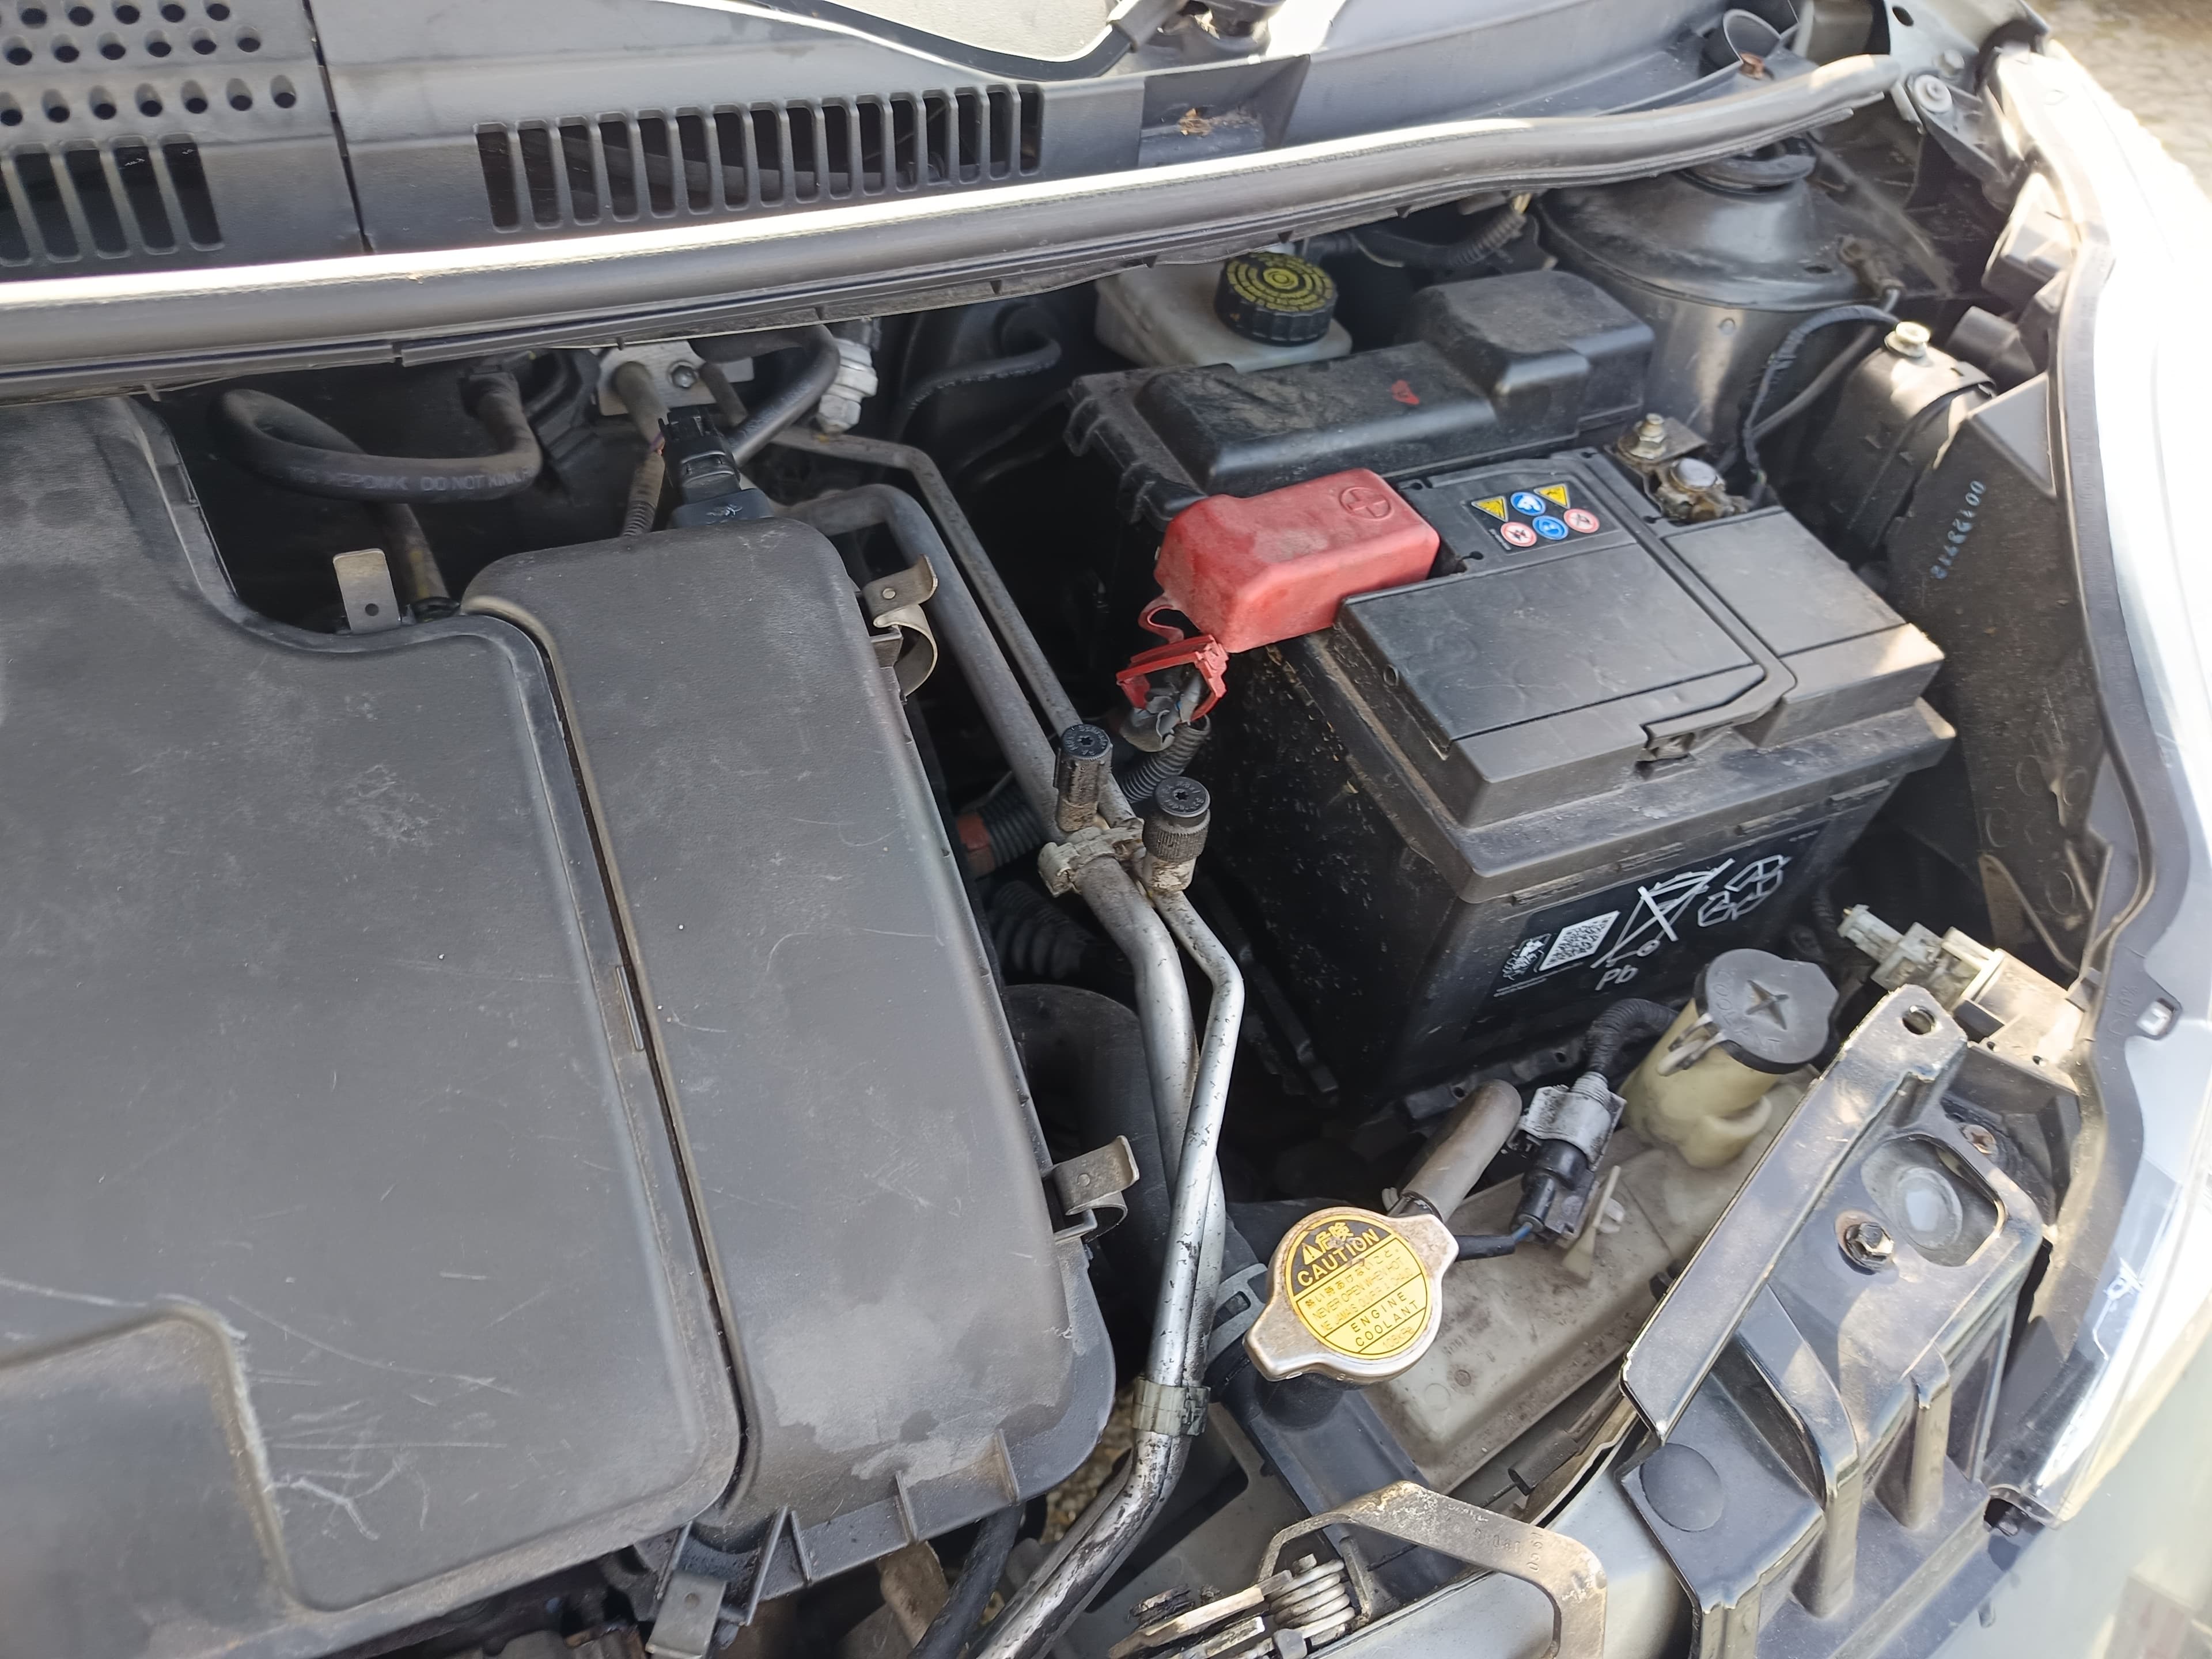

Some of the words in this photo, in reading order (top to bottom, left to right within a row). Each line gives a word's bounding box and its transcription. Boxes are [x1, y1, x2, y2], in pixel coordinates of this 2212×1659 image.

[1297, 1228, 1380, 1286] CAUTION
[1312, 1297, 1343, 1320] NEVER
[1342, 1282, 1366, 1302] OPEN
[1365, 1268, 1389, 1288] WHEN
[1385, 1256, 1403, 1274] HOT
[1351, 1291, 1407, 1333] ENGINE
[1355, 1300, 1419, 1347] COOLANT
